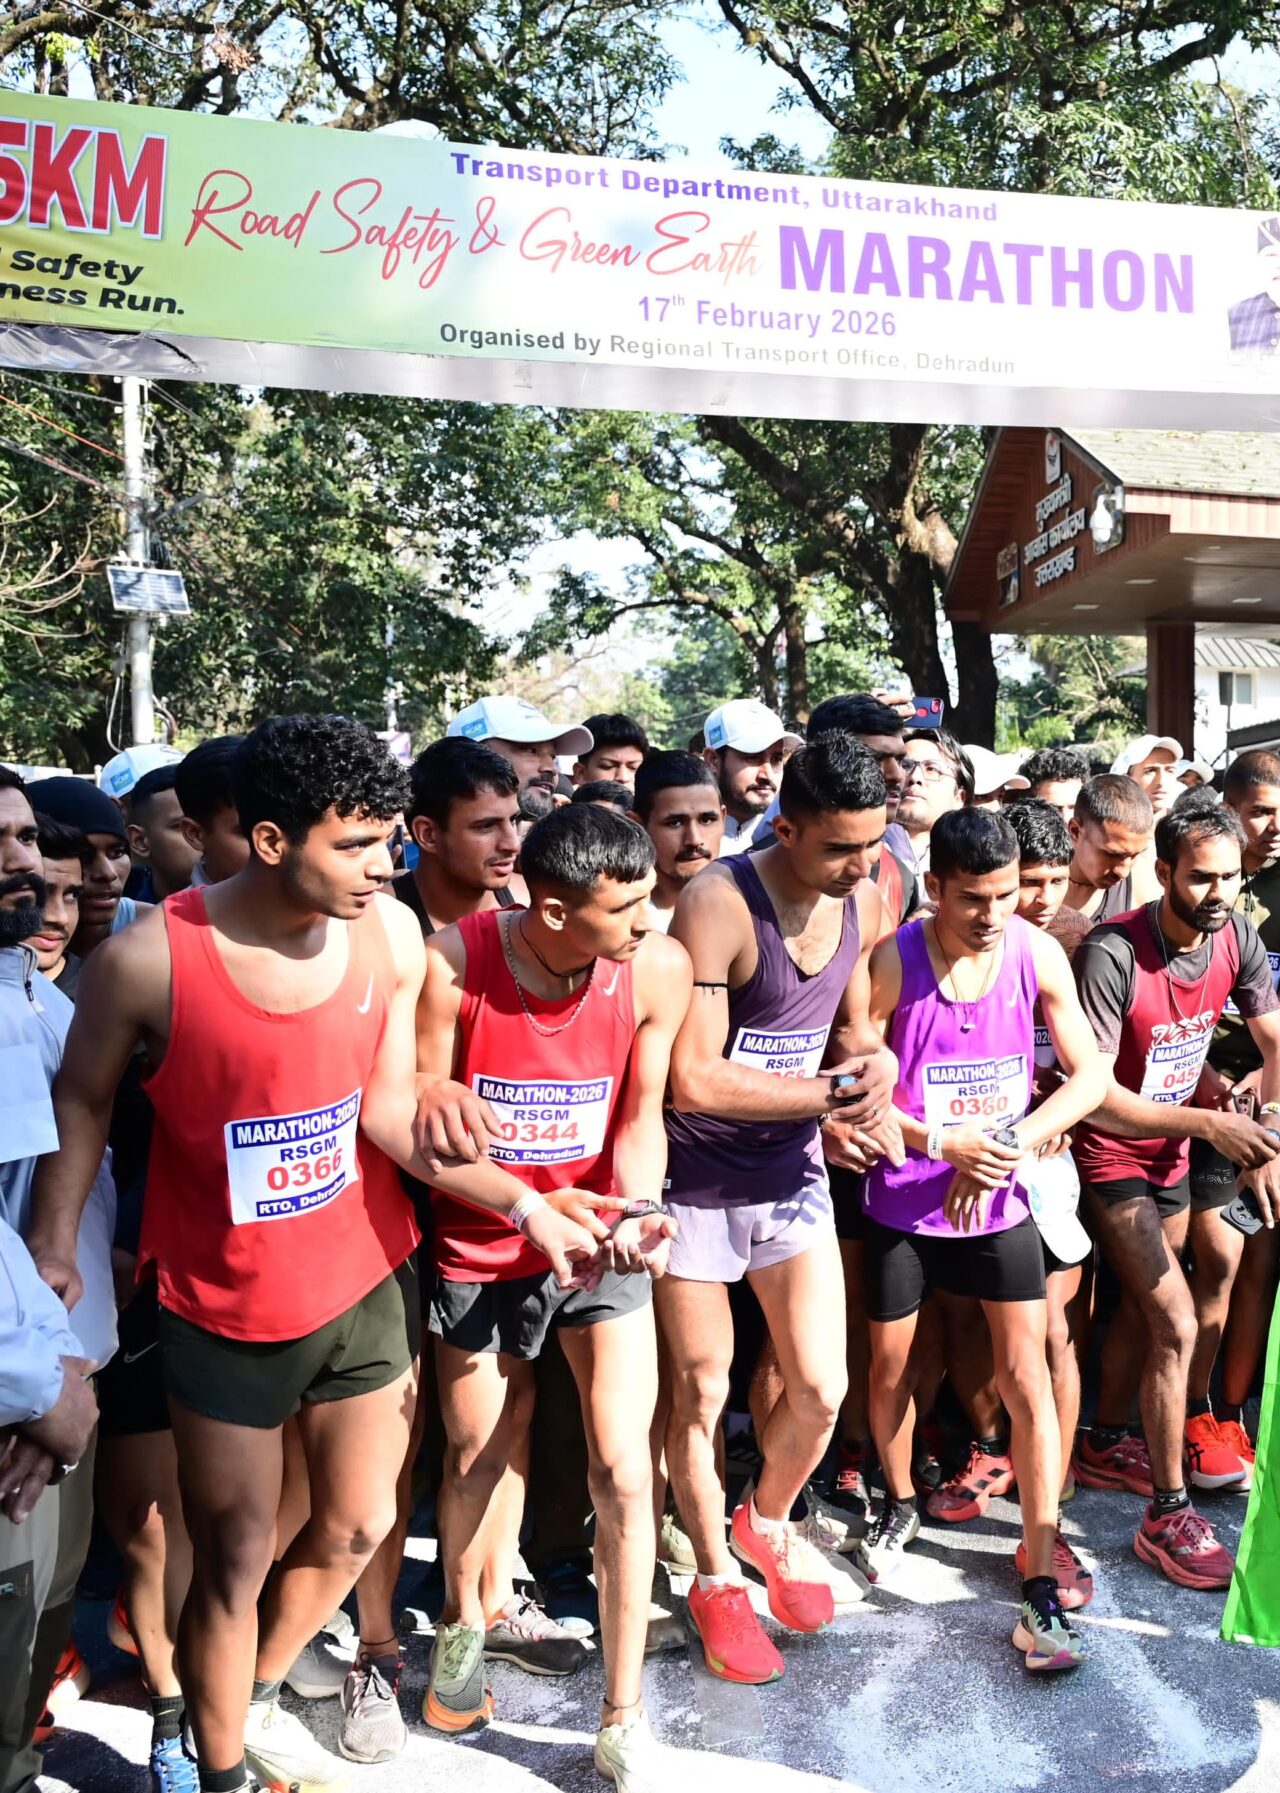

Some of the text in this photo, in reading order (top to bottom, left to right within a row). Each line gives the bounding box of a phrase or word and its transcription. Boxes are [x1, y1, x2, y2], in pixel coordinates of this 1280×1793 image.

[450, 152, 997, 222] Transport Department, Uttarakhand
[185, 169, 1195, 315] Road Safety & Green Earth MARATHON
[10, 249, 144, 286] Safety
[99, 287, 185, 315] Run.
[638, 294, 896, 339] 17th February 2026
[440, 323, 564, 350] Organised
[574, 331, 601, 356] by
[610, 334, 713, 360] Regional
[722, 341, 828, 367] Transport
[916, 352, 1015, 375] Dehradun
[765, 1057, 805, 1069] RSGM
[482, 1081, 604, 1103] MARATHON-2026
[236, 1097, 358, 1146] MARATHON-2026
[513, 1109, 570, 1121] RSGM
[500, 1121, 579, 1143] 0344
[280, 1135, 337, 1163] RSGM
[489, 1147, 583, 1162] RTO, Dehradun
[266, 1147, 343, 1191] 0366
[258, 1200, 297, 1215] RTO,
